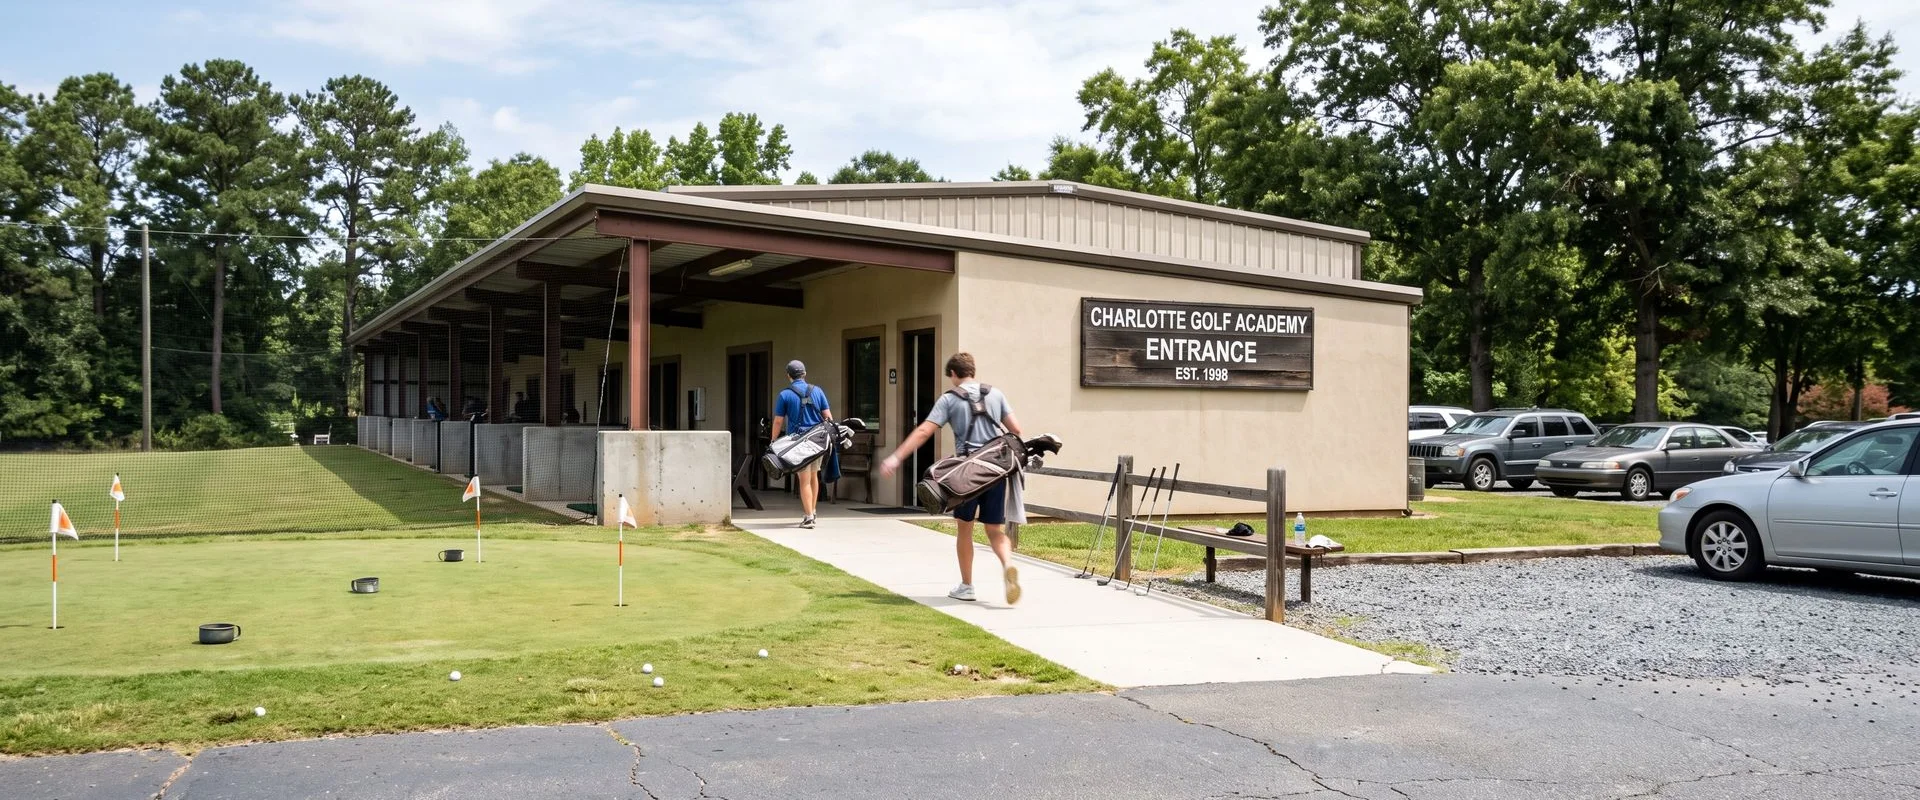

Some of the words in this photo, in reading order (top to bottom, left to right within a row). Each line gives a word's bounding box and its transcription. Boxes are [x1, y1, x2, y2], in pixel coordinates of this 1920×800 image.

[1091, 307, 1186, 329] CHARLOTTE
[1191, 311, 1231, 330] GOLF
[1235, 313, 1308, 334] ACADEMY
[1146, 338, 1257, 363] ENTRANCE
[1175, 367, 1200, 381] EST.
[1203, 368, 1228, 381] 1998
